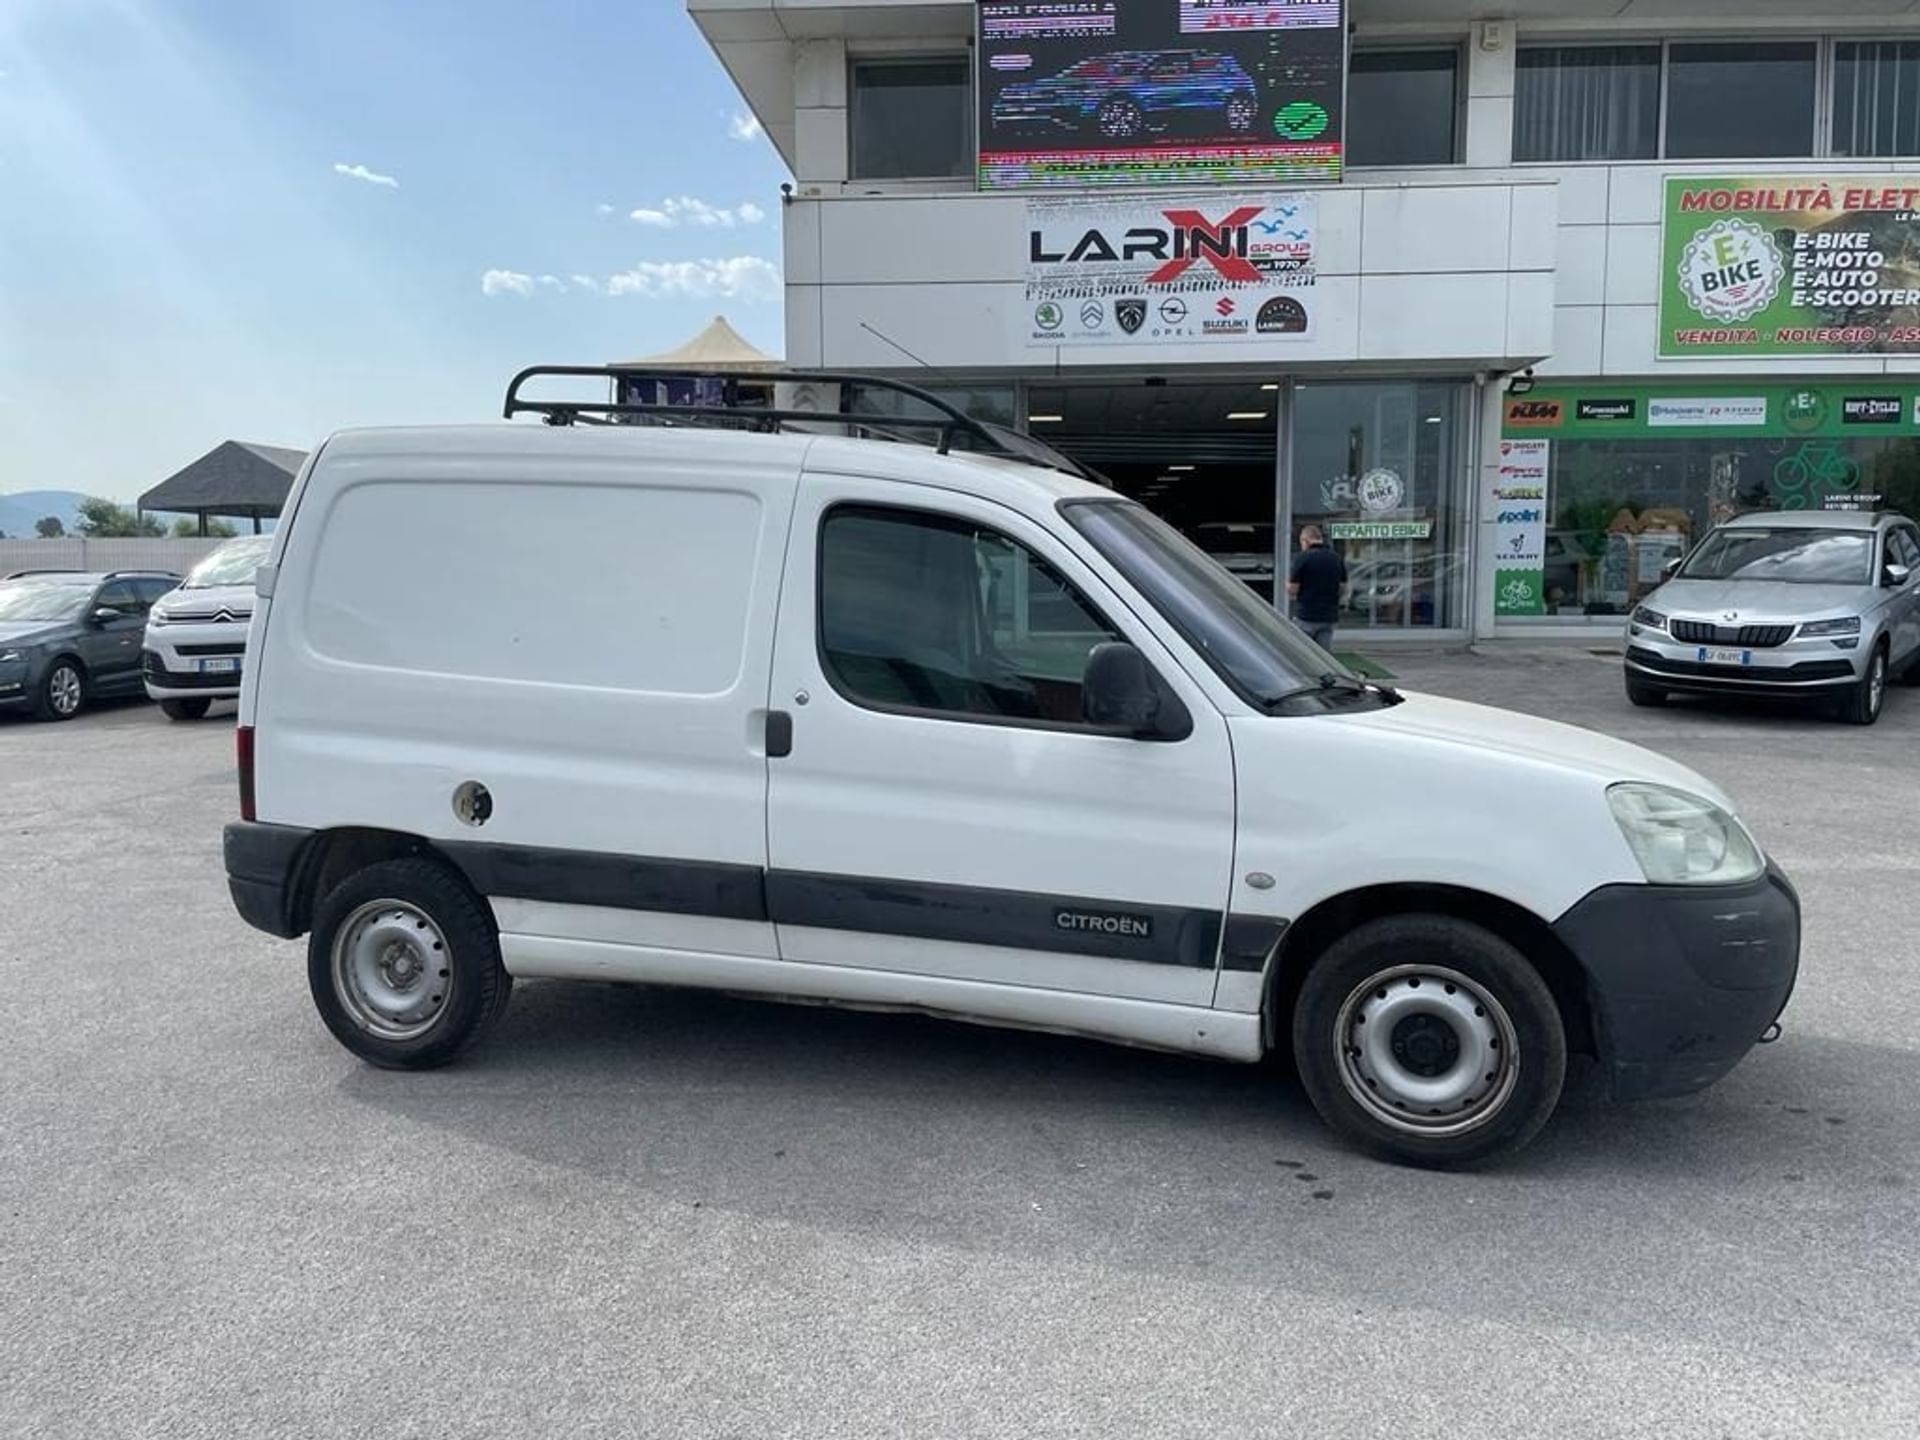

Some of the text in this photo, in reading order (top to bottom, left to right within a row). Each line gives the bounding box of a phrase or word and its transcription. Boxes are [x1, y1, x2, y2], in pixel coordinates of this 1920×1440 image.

[1681, 182, 1920, 211] MOBILITÀ ELET
[1895, 213, 1908, 221] LE
[1030, 226, 1248, 262] LARINI
[1250, 242, 1310, 253] GROUP
[1793, 232, 1871, 249] E-BIKE
[1713, 234, 1740, 266] E
[1274, 260, 1300, 269] 1970
[1792, 251, 1884, 268] E-MOTO
[1701, 259, 1763, 292] BIKE
[1791, 270, 1878, 287] E-AUTO
[1790, 289, 1920, 306] E-SCOOTER
[1203, 320, 1248, 328] SUZUKI
[1152, 328, 1194, 337] OPEL
[1675, 328, 1920, 343] VENDITA NOLEGGIO AS
[1798, 394, 1809, 408] E
[1509, 402, 1559, 418] KTM
[1582, 405, 1629, 414] Kawasaki
[1367, 487, 1393, 500] BIKE
[1333, 525, 1427, 537] REPARTO EBIKE
[1057, 913, 1148, 936] CITROËN
